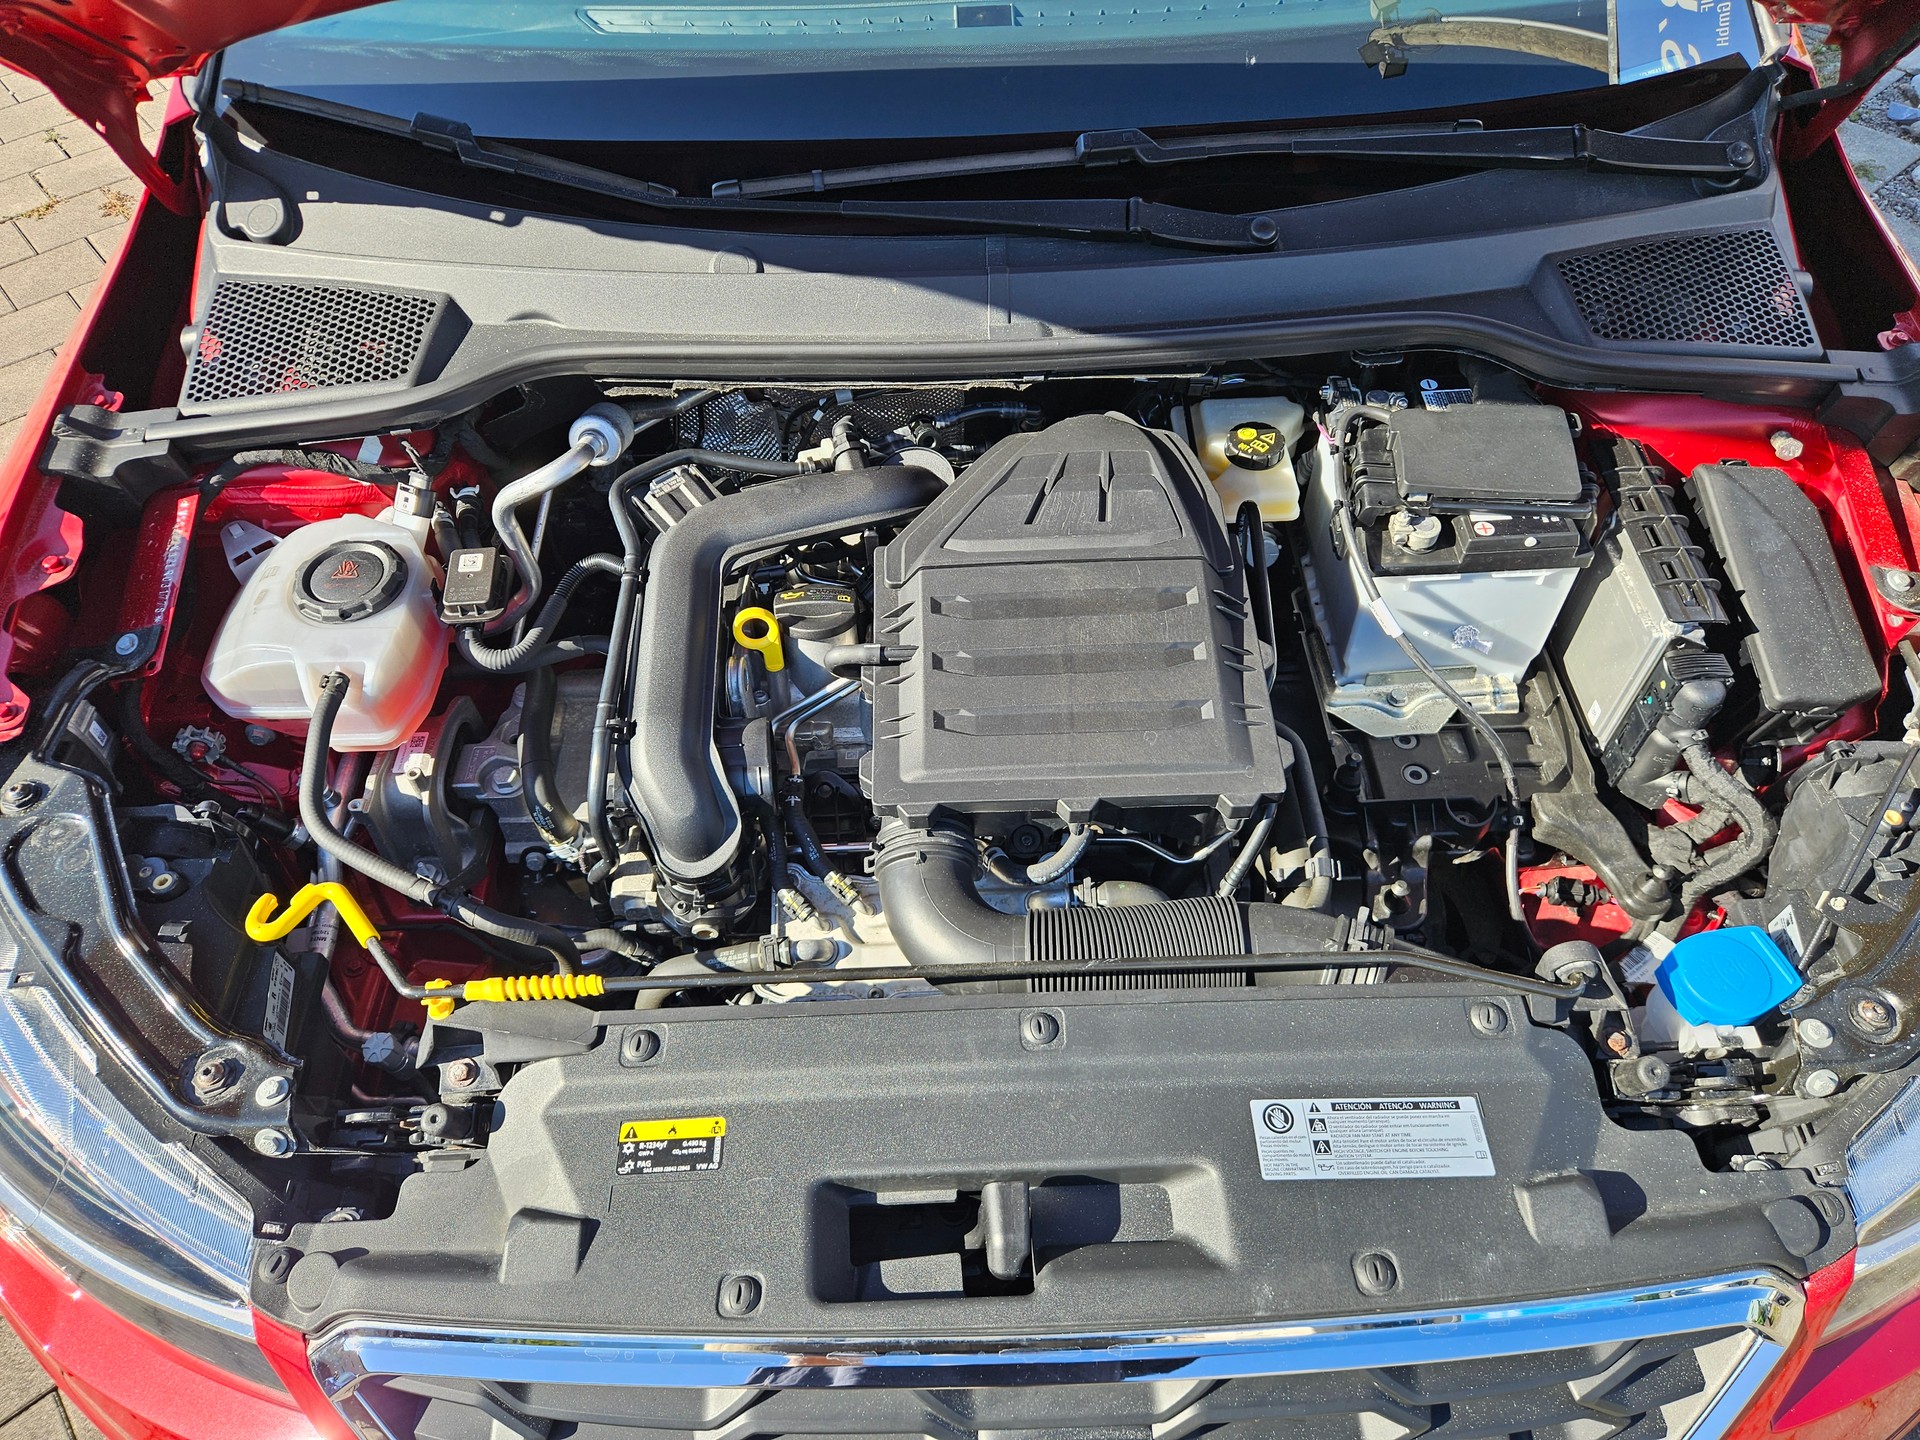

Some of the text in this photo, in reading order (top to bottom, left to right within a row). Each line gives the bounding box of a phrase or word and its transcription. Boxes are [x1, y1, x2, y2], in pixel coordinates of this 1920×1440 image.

[1335, 1101, 1456, 1110] ATENCIÓN ATENÇÃO WARNING
[638, 1140, 668, 1150] R-1234yf
[636, 1160, 652, 1168] PAG
